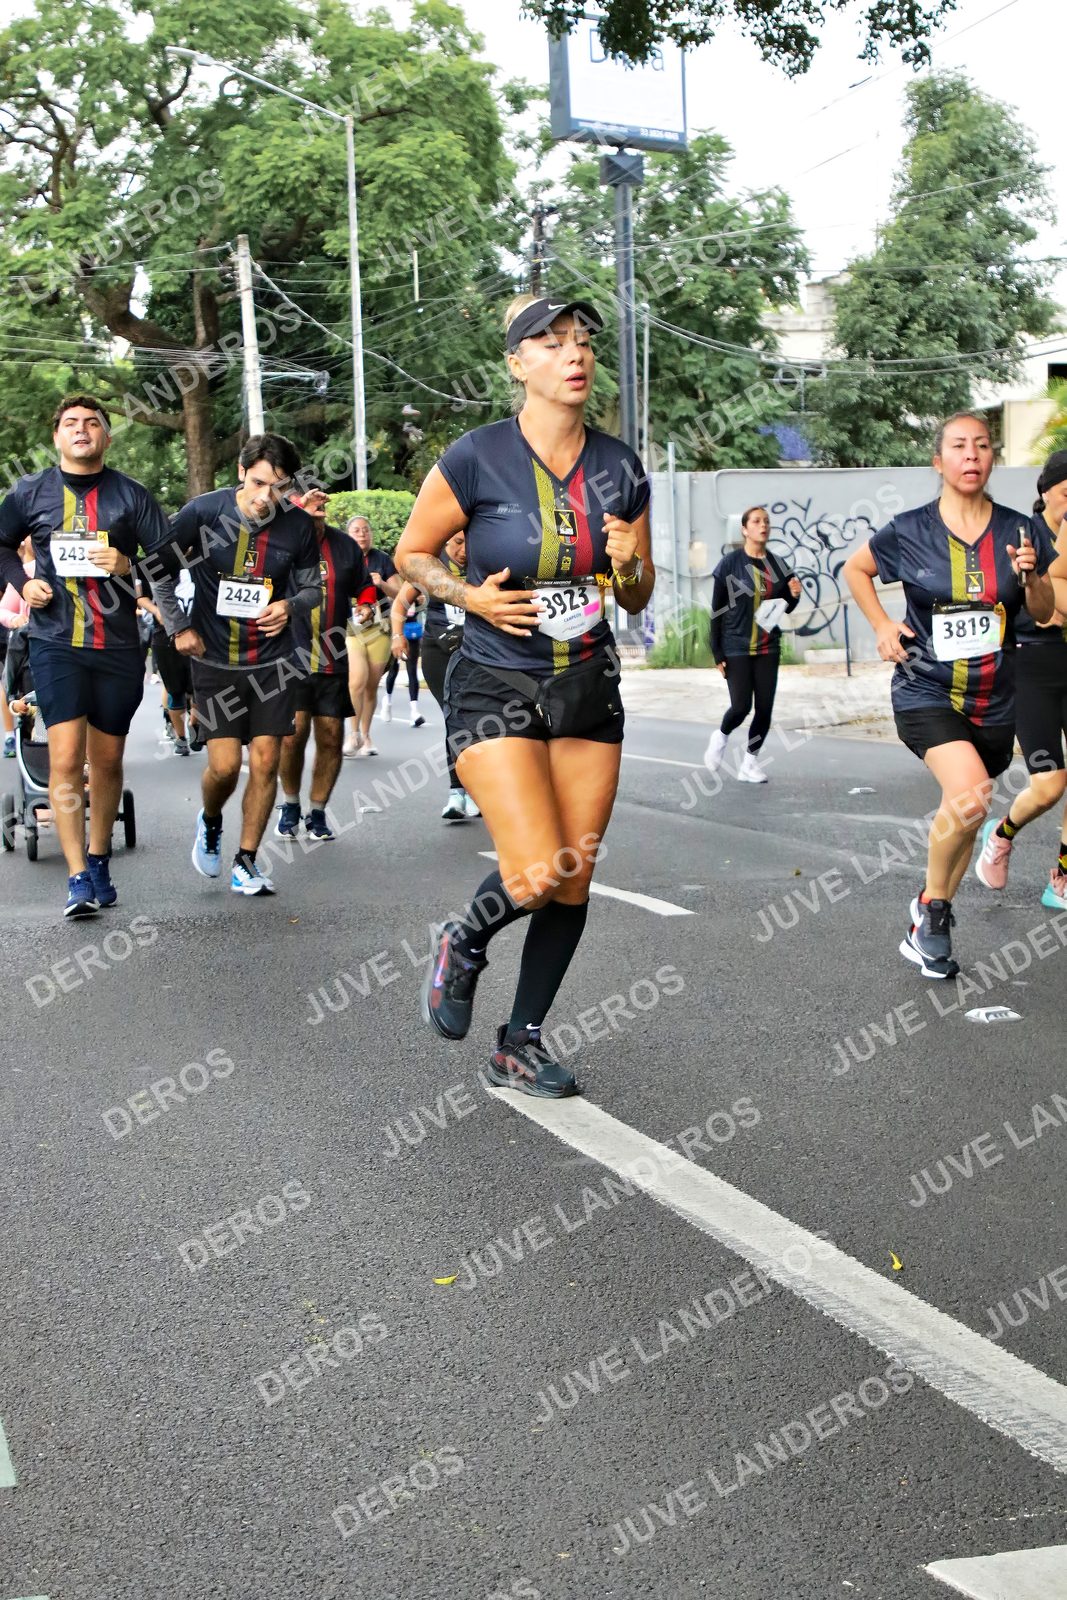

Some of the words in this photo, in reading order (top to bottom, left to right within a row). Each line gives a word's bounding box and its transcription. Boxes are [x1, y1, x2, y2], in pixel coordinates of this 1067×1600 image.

[58, 546, 88, 561] 243
[225, 587, 261, 604] 2424
[541, 586, 590, 620] 3923
[943, 616, 990, 639] 3819
